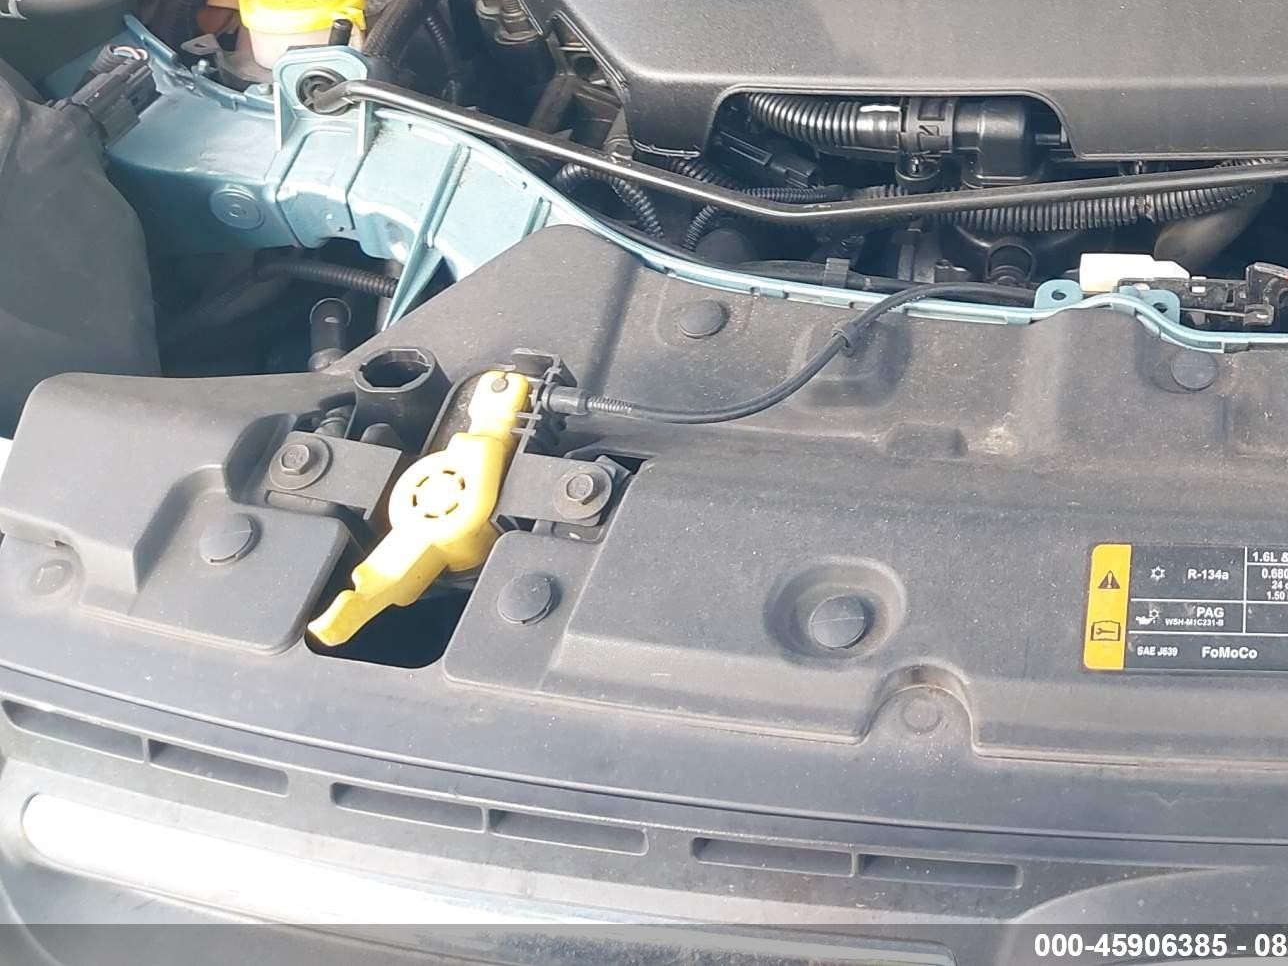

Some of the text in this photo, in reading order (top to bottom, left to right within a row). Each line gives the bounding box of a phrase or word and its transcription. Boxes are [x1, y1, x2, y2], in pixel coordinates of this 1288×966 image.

[1252, 551, 1278, 563] 1.6L
[1187, 568, 1229, 581] R-134a
[1271, 580, 1283, 590] 24
[1266, 591, 1285, 601] 1.50
[1196, 606, 1225, 619] PAG
[1136, 646, 1157, 656] SAE
[1201, 645, 1258, 659] FoMoCo
